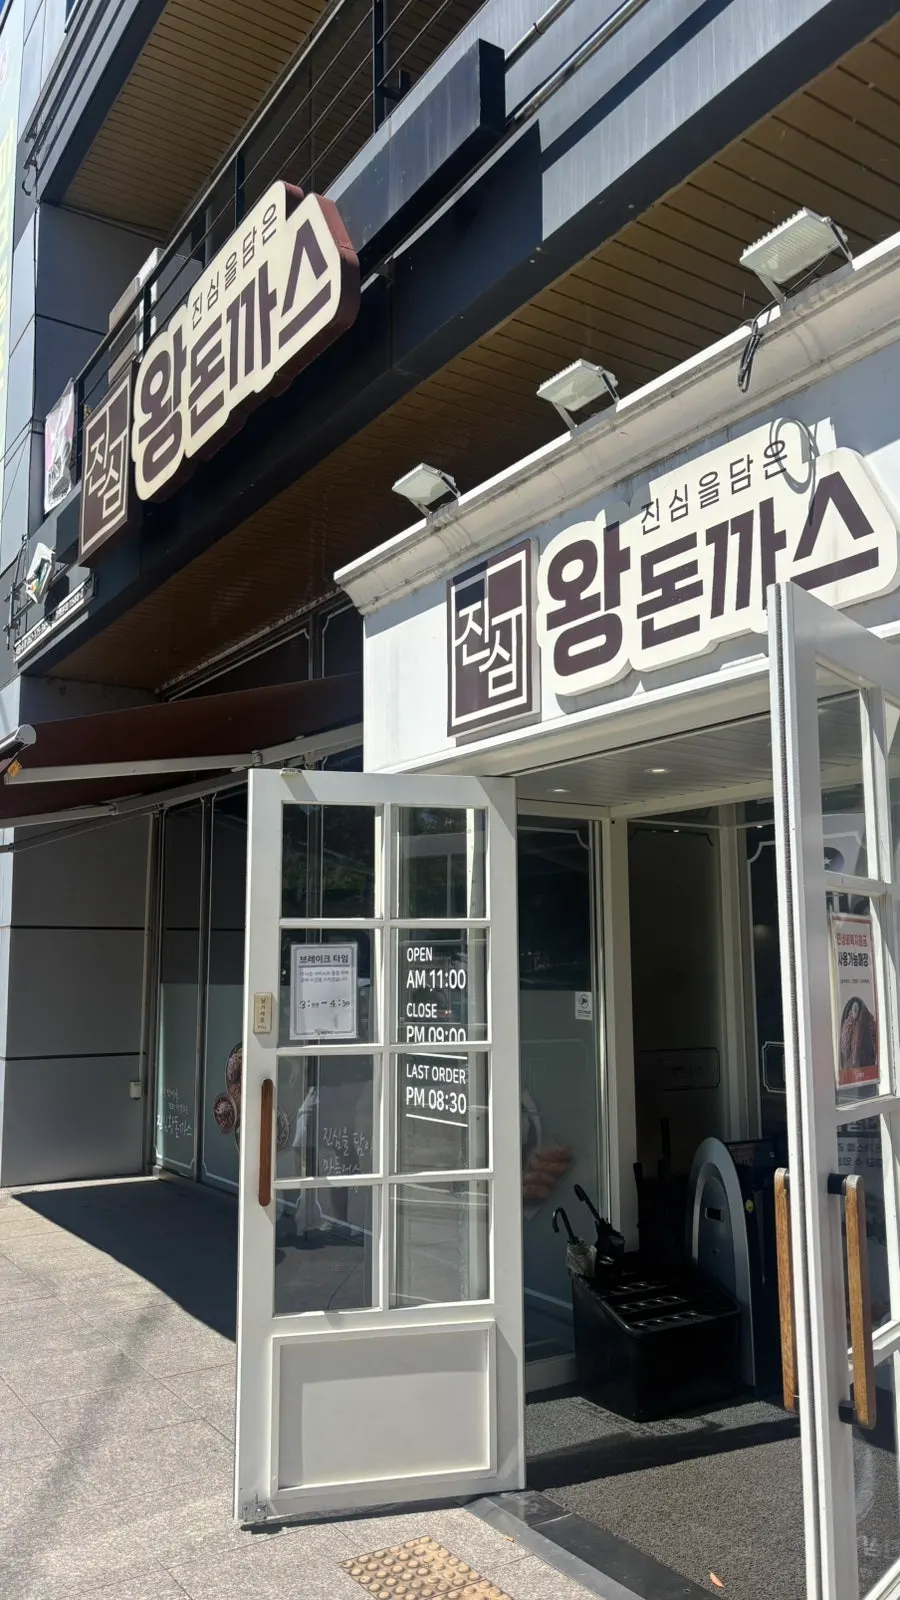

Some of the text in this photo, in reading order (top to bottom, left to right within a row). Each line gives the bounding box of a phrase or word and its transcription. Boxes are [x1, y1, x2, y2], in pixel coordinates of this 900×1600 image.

[138, 220, 333, 479] 왕돈까스
[87, 420, 127, 514] 진심
[546, 471, 880, 676] 왕돈까스
[456, 597, 523, 697] 진심
[299, 954, 349, 964] 브레이크 타임
[406, 946, 432, 962] OPEN
[838, 951, 869, 967] 사용가능매장
[406, 969, 467, 989] AM 11:00
[406, 1002, 437, 1018] CLOSE
[406, 1026, 467, 1043] PM 09:00
[406, 1064, 466, 1084] LAST ORDER
[406, 1086, 467, 1115] PM 08:30
[322, 1127, 349, 1156] 진심을
